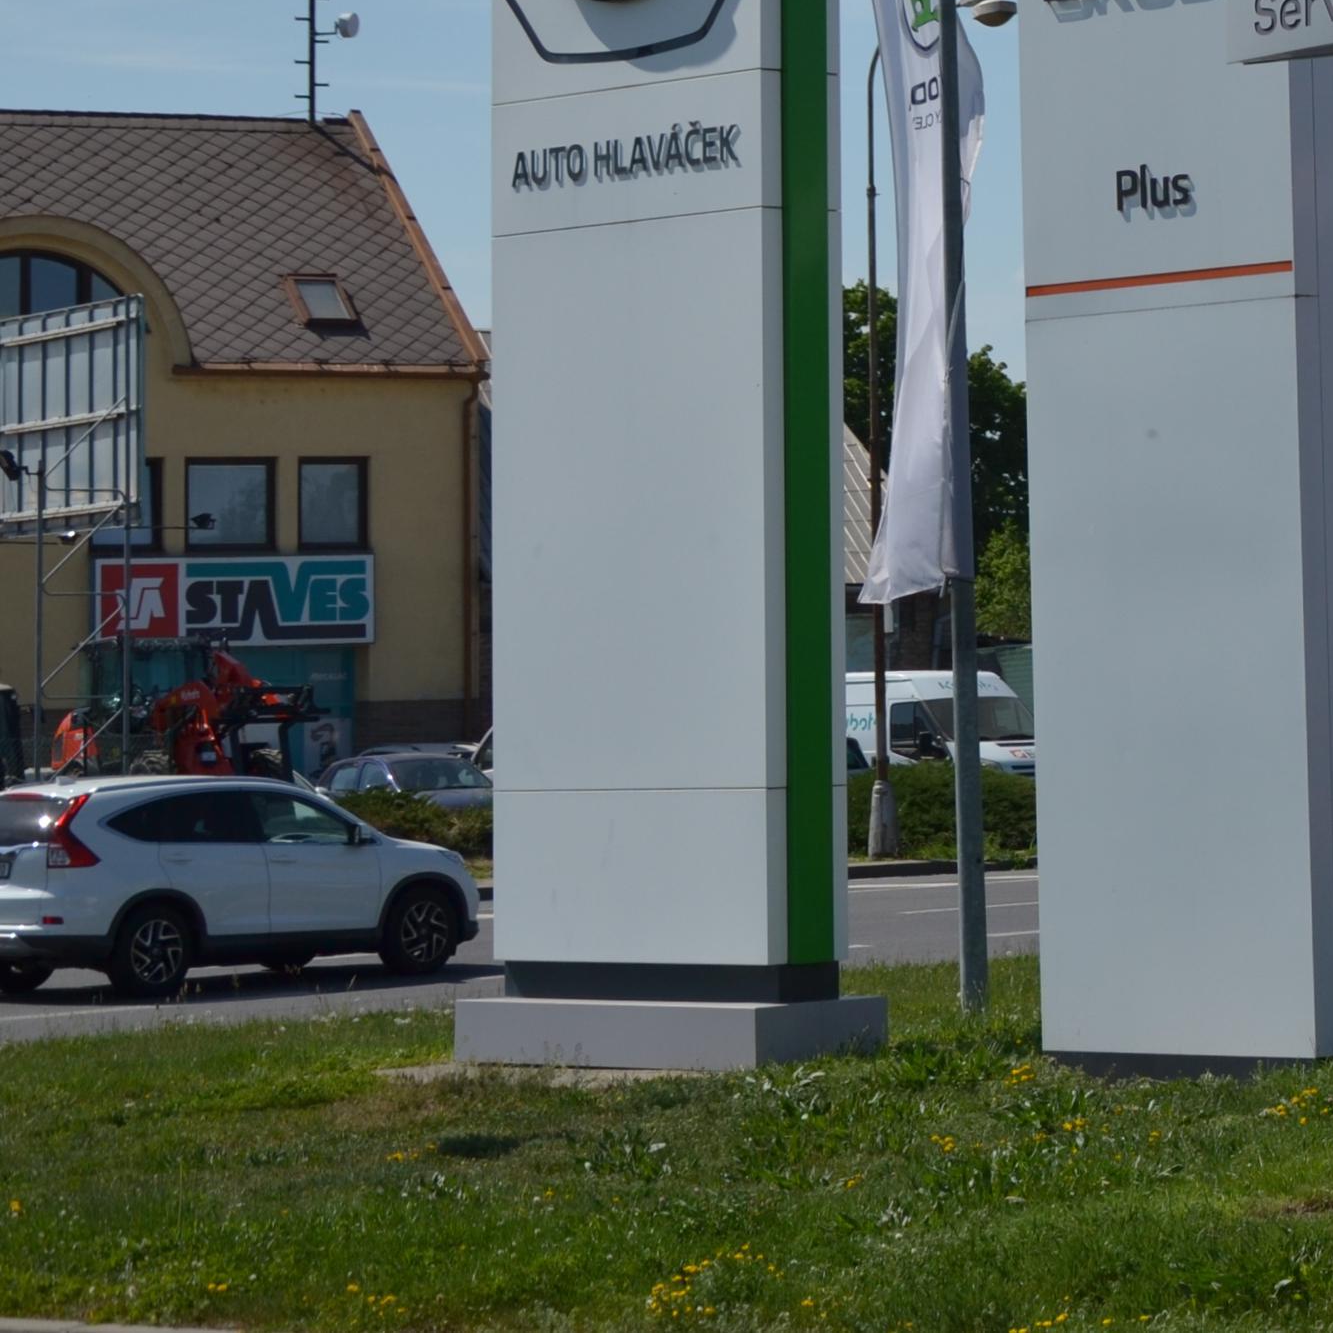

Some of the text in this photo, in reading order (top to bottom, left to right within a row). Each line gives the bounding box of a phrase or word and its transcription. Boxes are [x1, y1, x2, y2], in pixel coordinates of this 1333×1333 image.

[511, 120, 739, 189] AUTO HLAVÁČEK
[1116, 164, 1191, 212] Plus
[186, 566, 369, 635] STAVES
